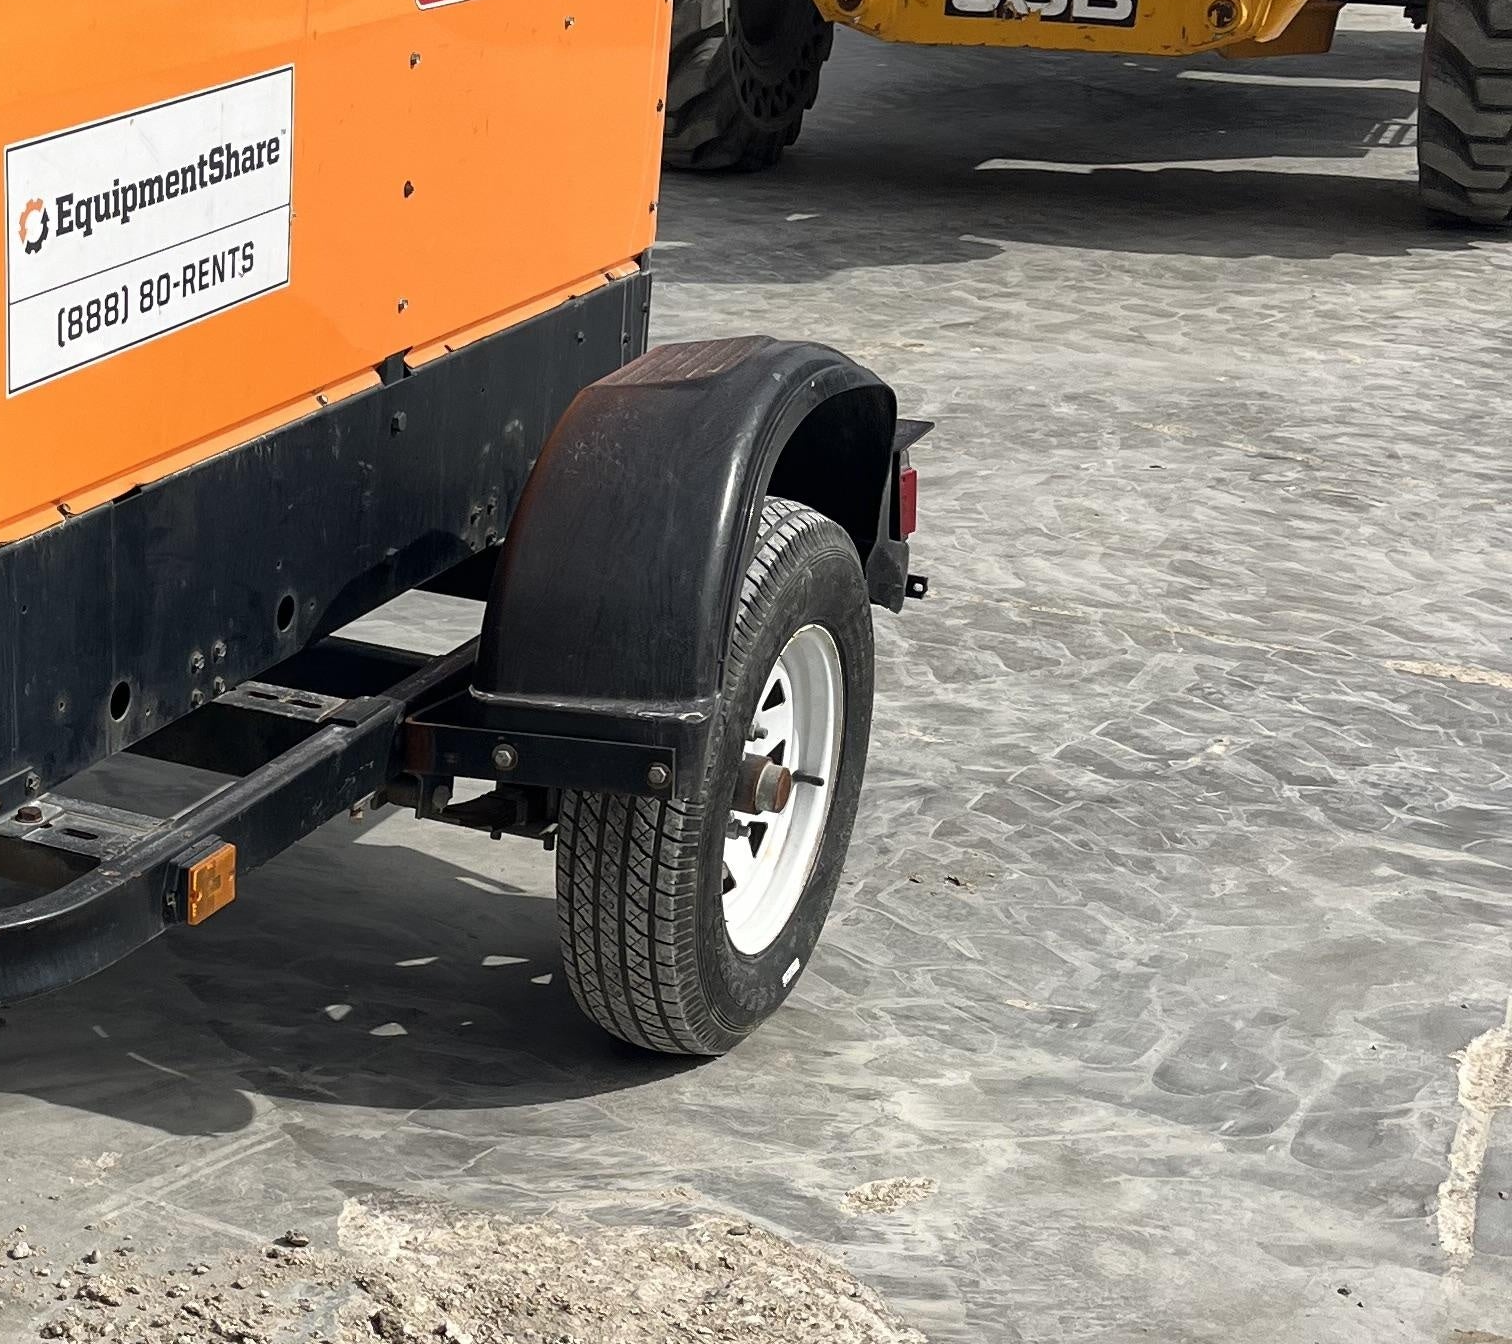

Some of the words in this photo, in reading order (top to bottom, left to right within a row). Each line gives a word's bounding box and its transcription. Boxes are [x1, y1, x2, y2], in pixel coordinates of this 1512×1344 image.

[55, 135, 280, 238] EquipmentShare
[57, 285, 128, 348] (888)
[139, 241, 255, 314] 80-RENTS
